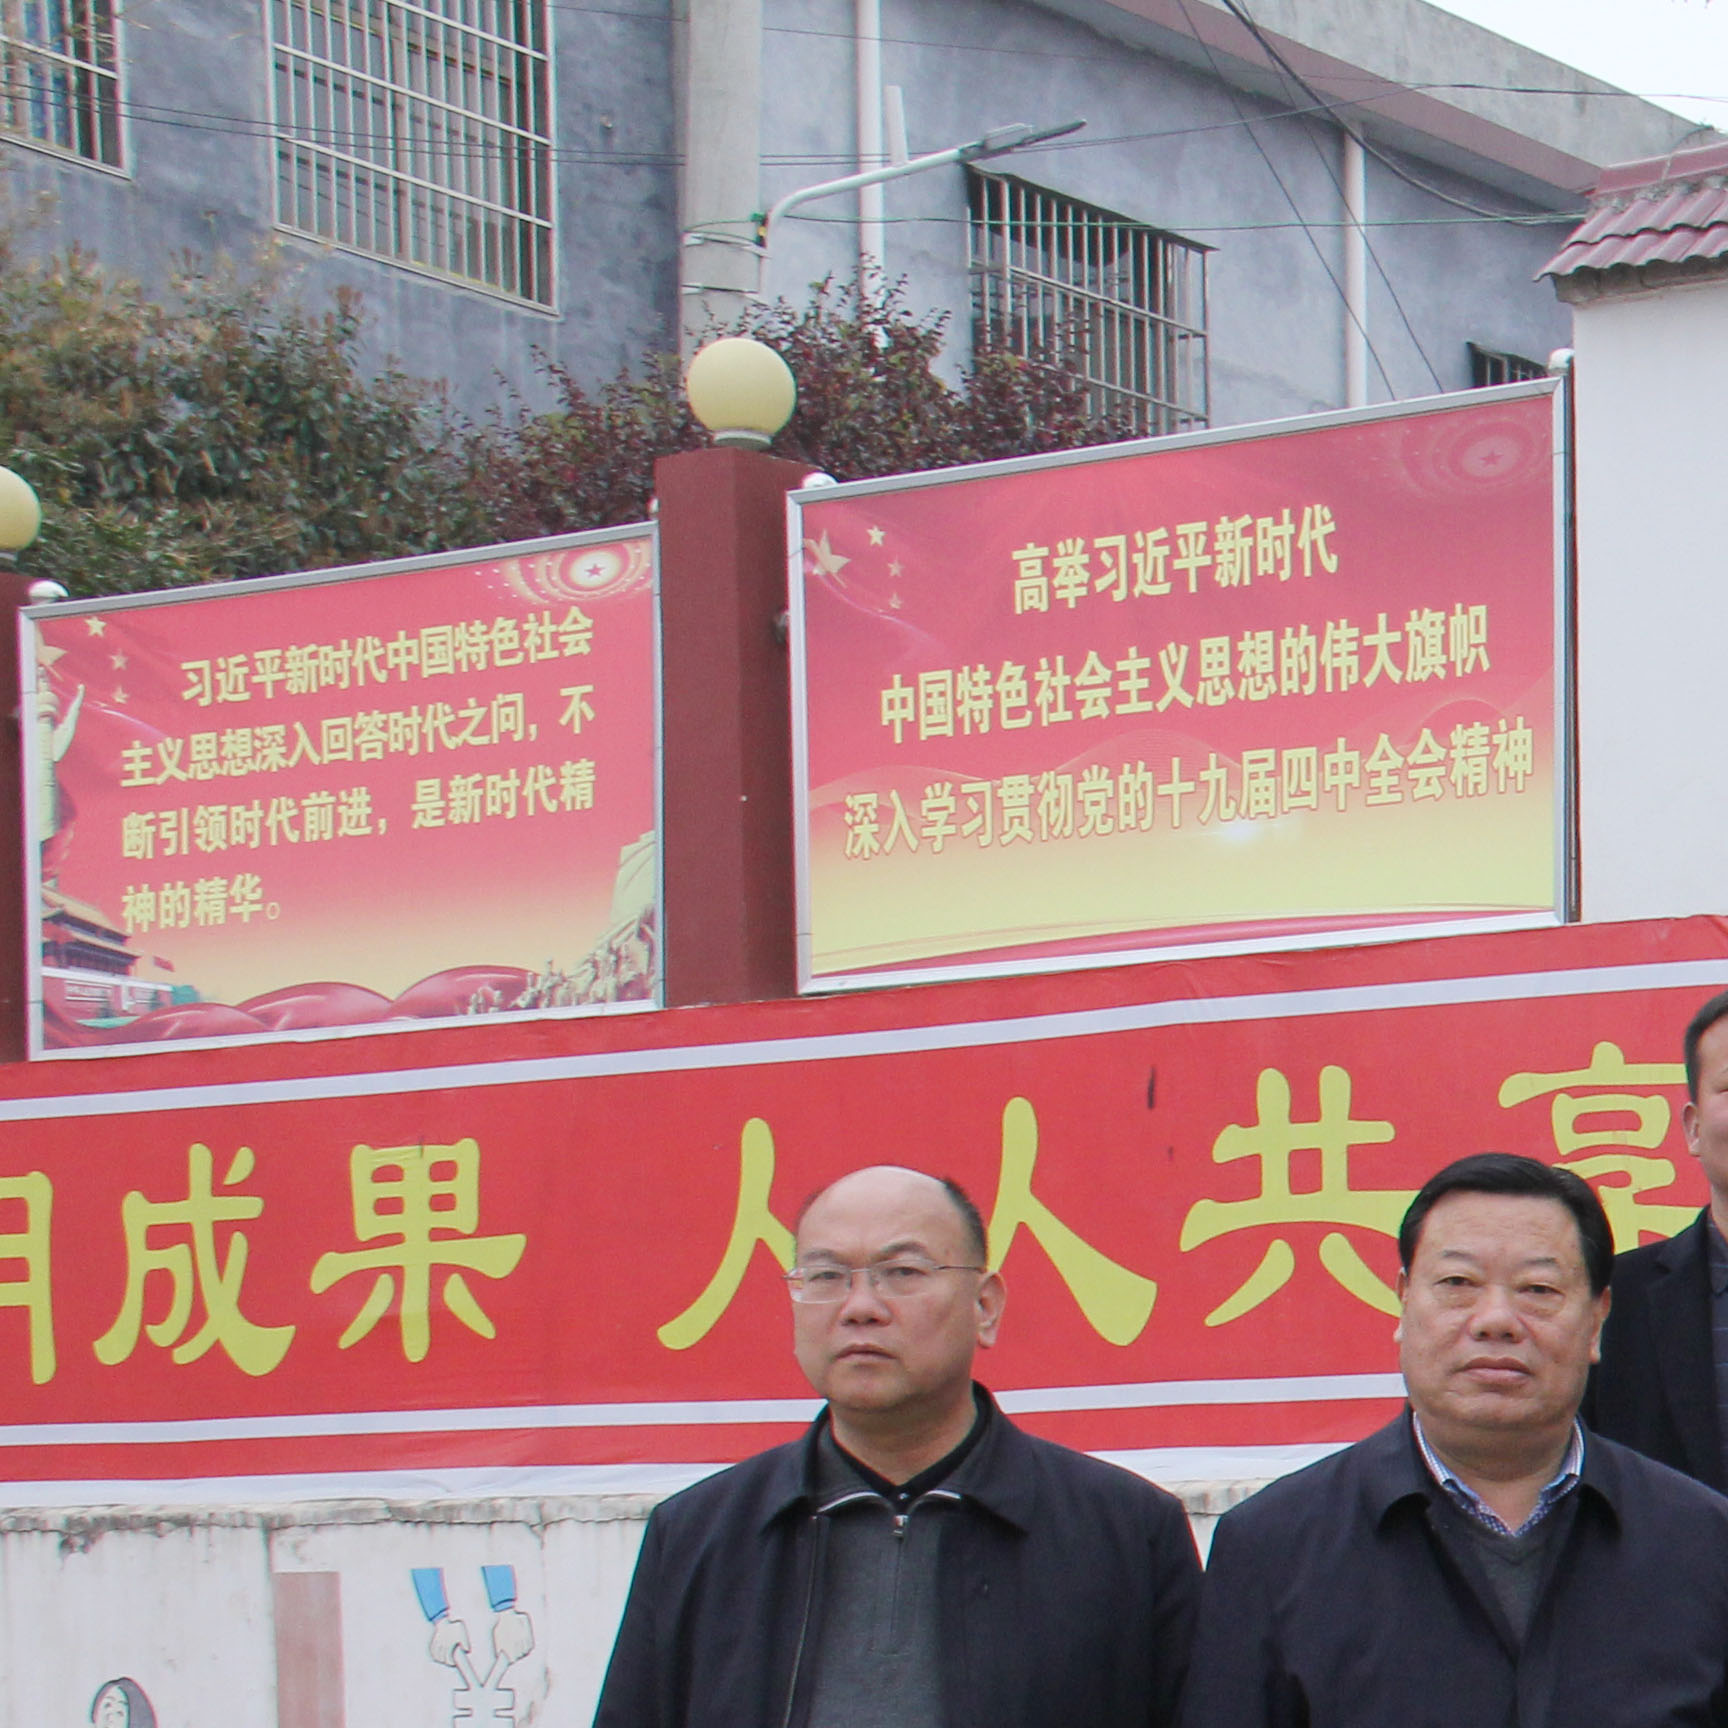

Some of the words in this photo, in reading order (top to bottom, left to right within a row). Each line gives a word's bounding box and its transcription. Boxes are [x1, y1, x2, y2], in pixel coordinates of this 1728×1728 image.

[1012, 503, 1339, 615] 高举习近平新时代
[180, 605, 594, 708] 习近平新时代中国特色社会
[880, 602, 1490, 745] 中国特色社会主义思想的伟大旗帜
[120, 683, 596, 789] 主义思想深入回答时代之问，不
[843, 716, 1536, 861] 深入学习贯彻党的十九届四中全会精神
[121, 758, 596, 861] 断引领时代前进，是新时代精
